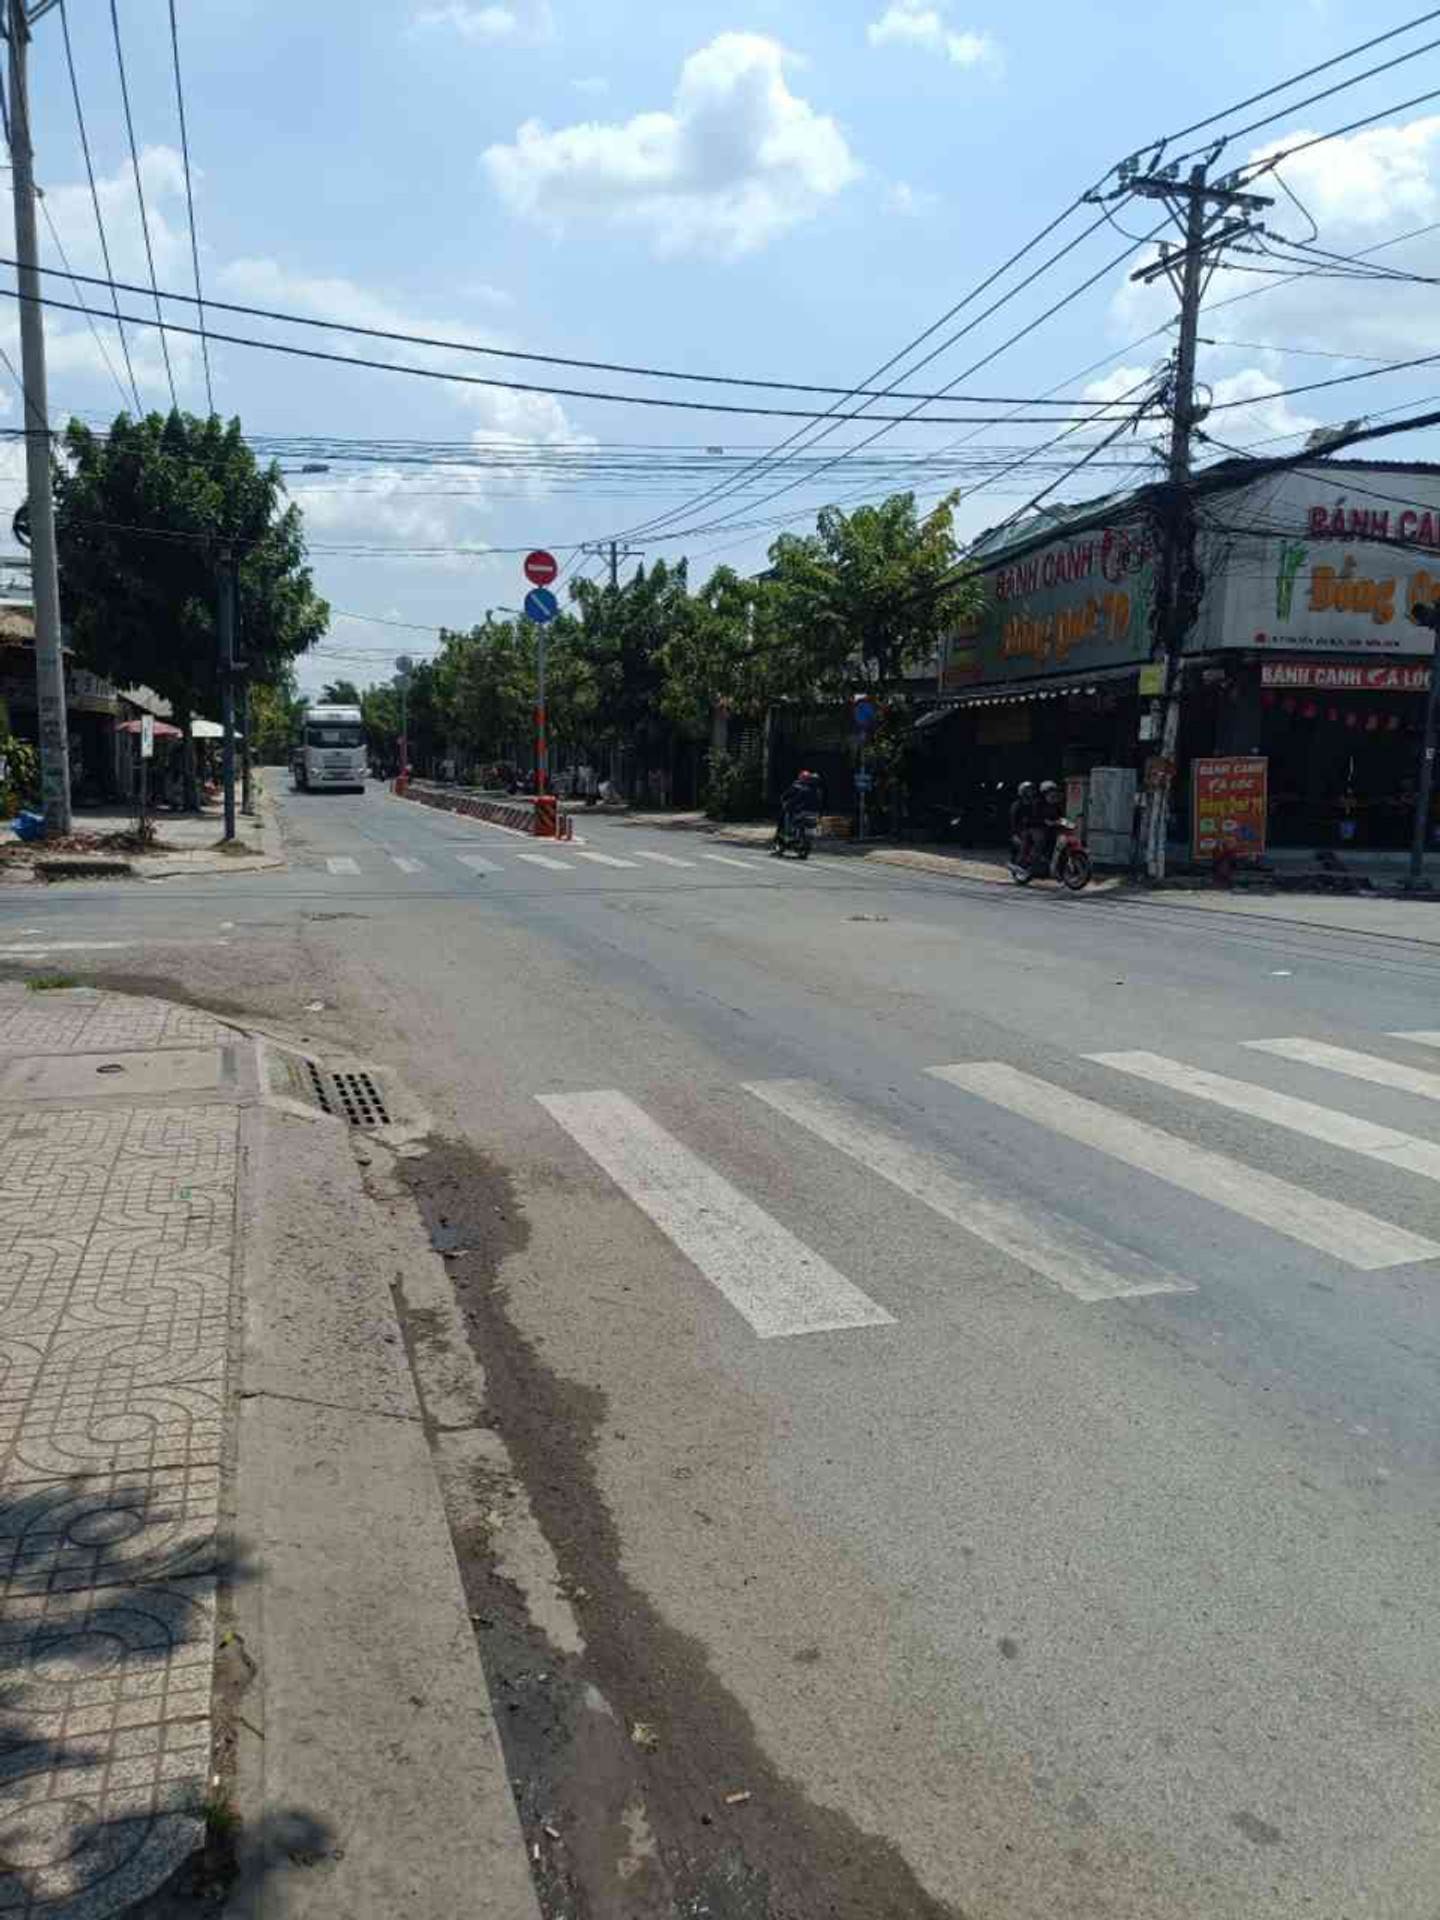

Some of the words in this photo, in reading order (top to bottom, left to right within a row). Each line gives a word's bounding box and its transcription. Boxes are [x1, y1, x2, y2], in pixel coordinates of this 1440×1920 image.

[1308, 497, 1390, 541] BÁNH
[1397, 508, 1440, 549] CA
[1261, 661, 1310, 685] BÁNH
[1314, 664, 1361, 686] CANH
